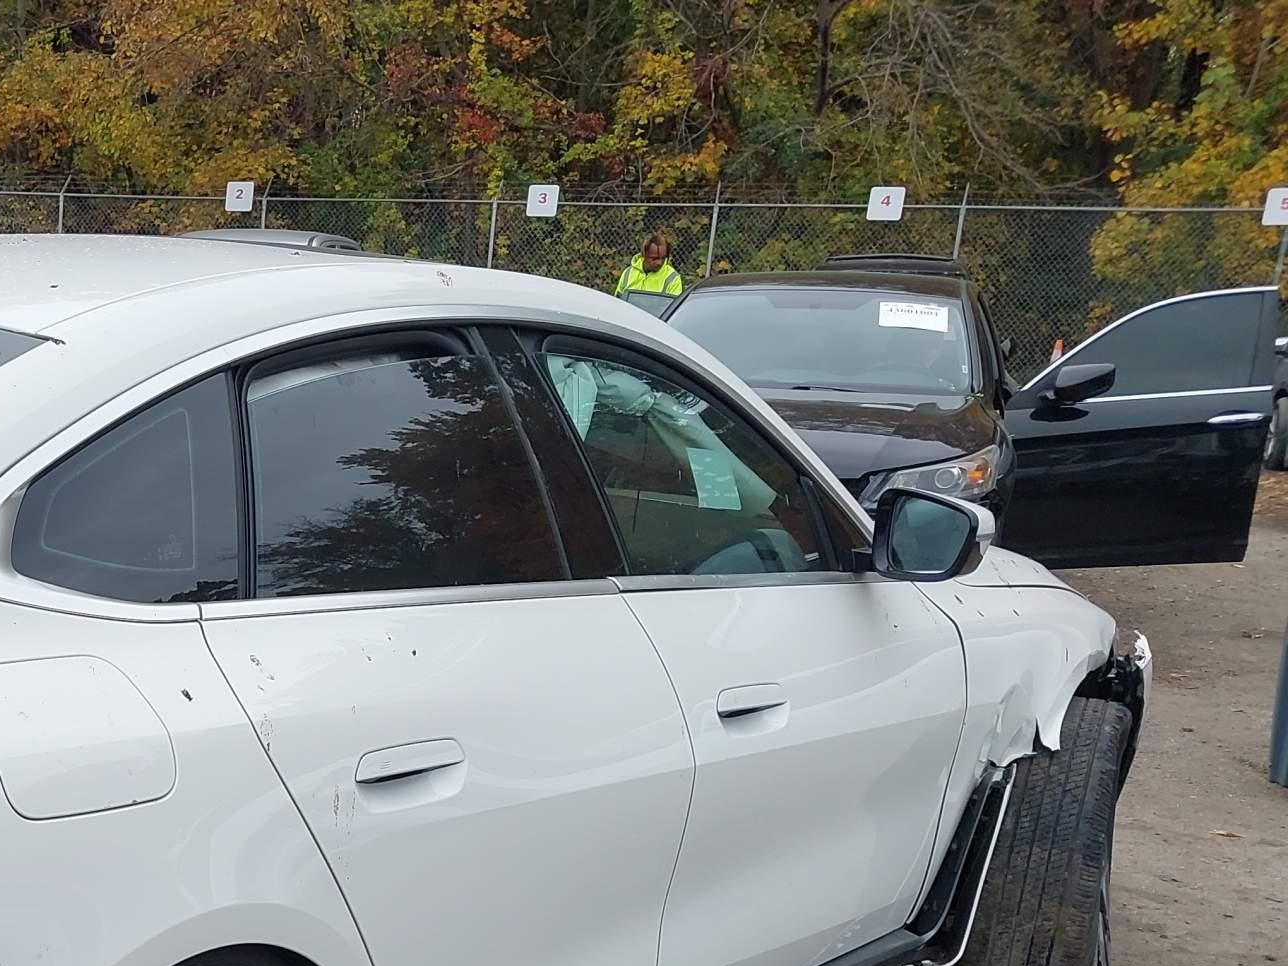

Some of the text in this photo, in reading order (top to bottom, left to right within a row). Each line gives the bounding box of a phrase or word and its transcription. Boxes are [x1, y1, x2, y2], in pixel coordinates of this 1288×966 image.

[235, 189, 244, 200] 2
[538, 192, 548, 204] 3
[880, 195, 891, 207] 4
